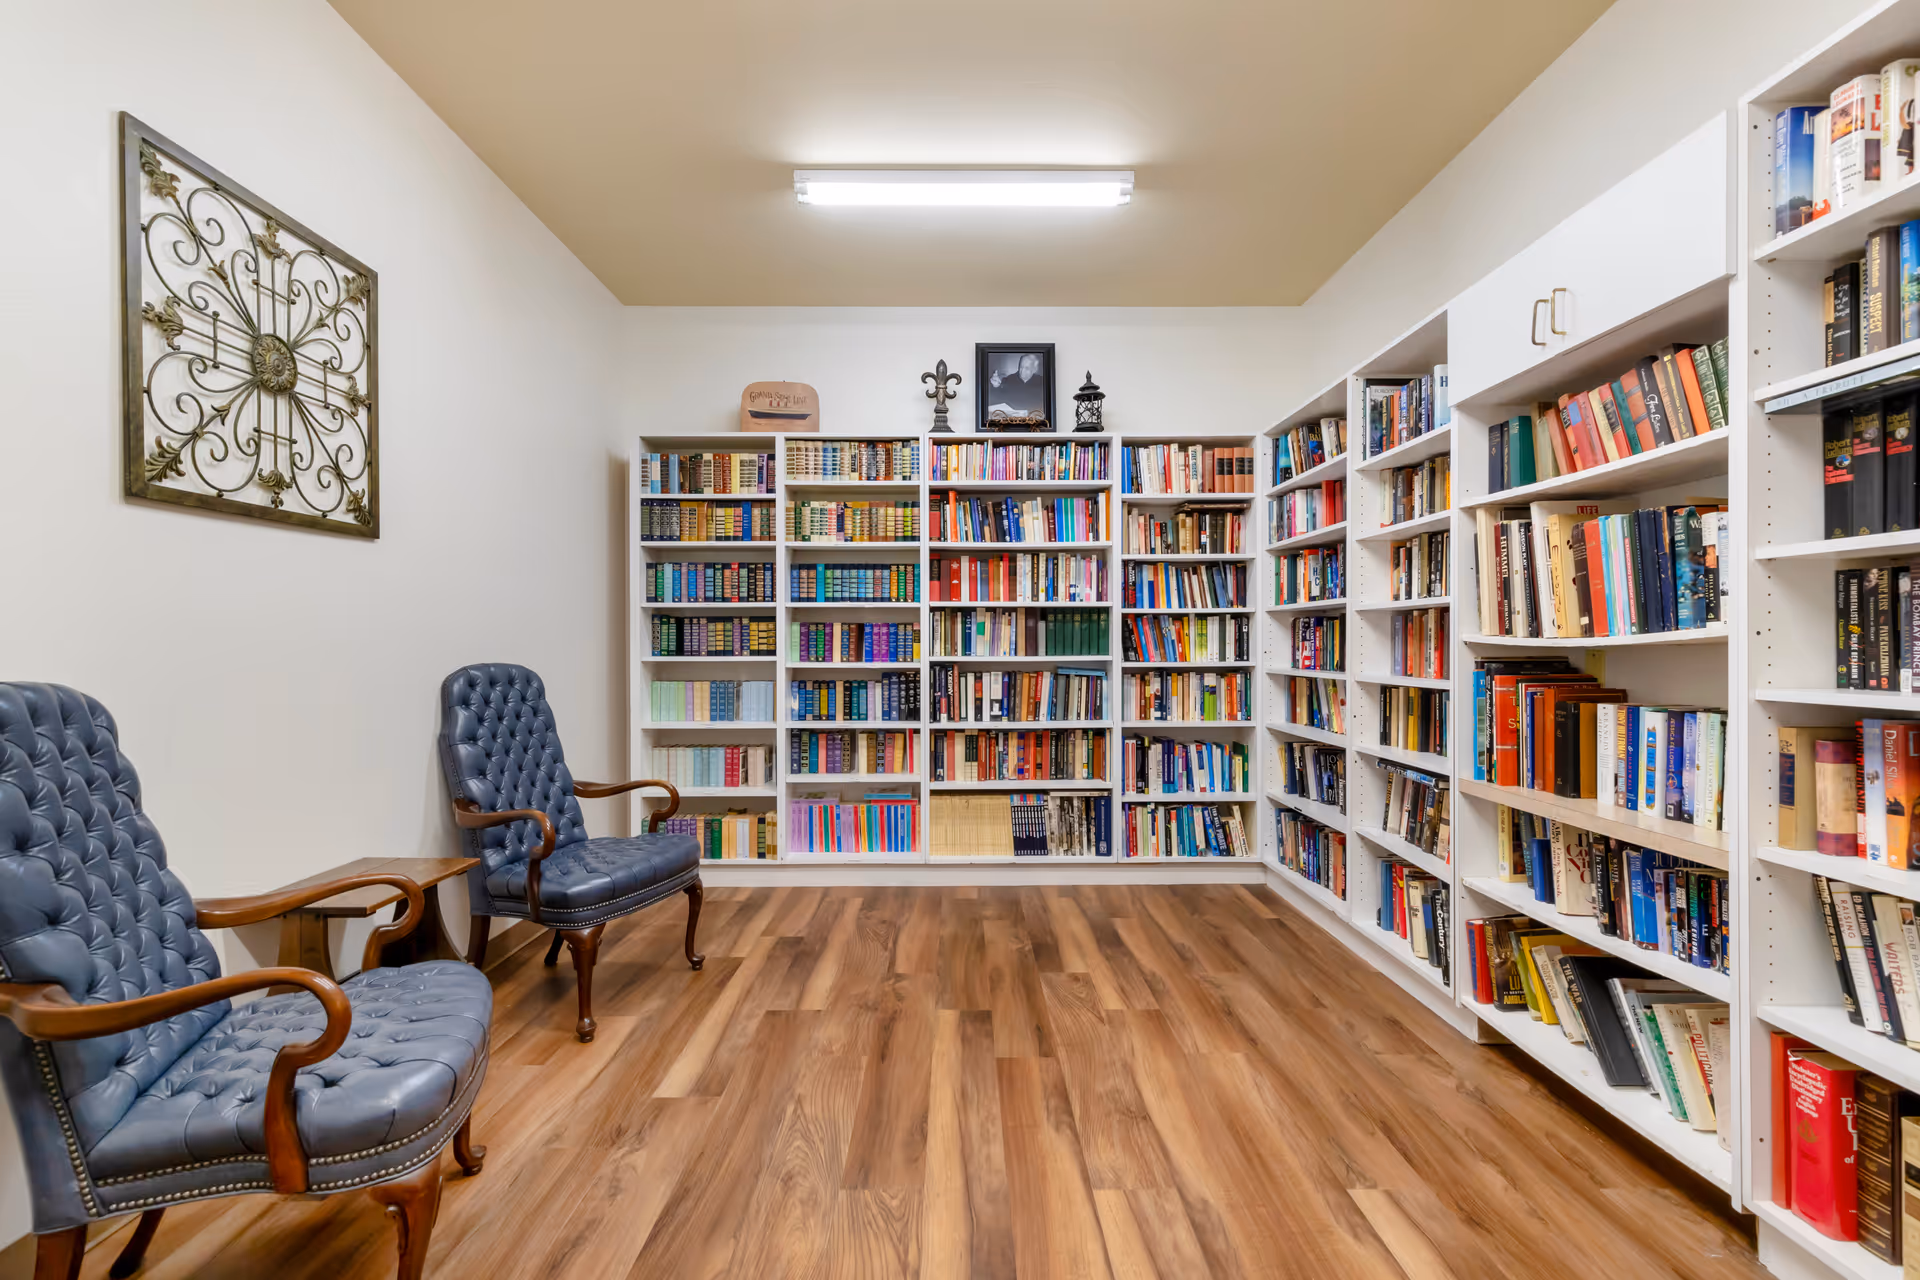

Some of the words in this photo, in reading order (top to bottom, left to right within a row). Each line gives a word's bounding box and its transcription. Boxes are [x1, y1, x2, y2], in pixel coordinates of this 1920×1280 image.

[1870, 292, 1882, 334] SUSPECT
[1577, 506, 1598, 514] LIFE
[1878, 570, 1888, 593] STONE
[1850, 583, 1859, 624] IMMORTALISTS
[1879, 594, 1888, 610] KISS
[1880, 626, 1889, 641] FAYE
[1880, 642, 1889, 676] KELLERMAN
[1618, 725, 1626, 758] HILLERMAN
[1884, 730, 1897, 762] Daniel
[1886, 766, 1898, 789] Silva
[1216, 829, 1227, 850] PIRATE
[1817, 877, 1831, 904] TRUMP
[1840, 899, 1856, 939] RAISING
[1905, 927, 1917, 950] BOB
[1884, 942, 1906, 995] WALTERS
[1562, 964, 1574, 981] THE
[1570, 983, 1582, 1003] WAR
[1693, 1033, 1714, 1085] POLITICIAN
[1792, 1062, 1821, 1080] Webster's
[1844, 1155, 1854, 1164] of
